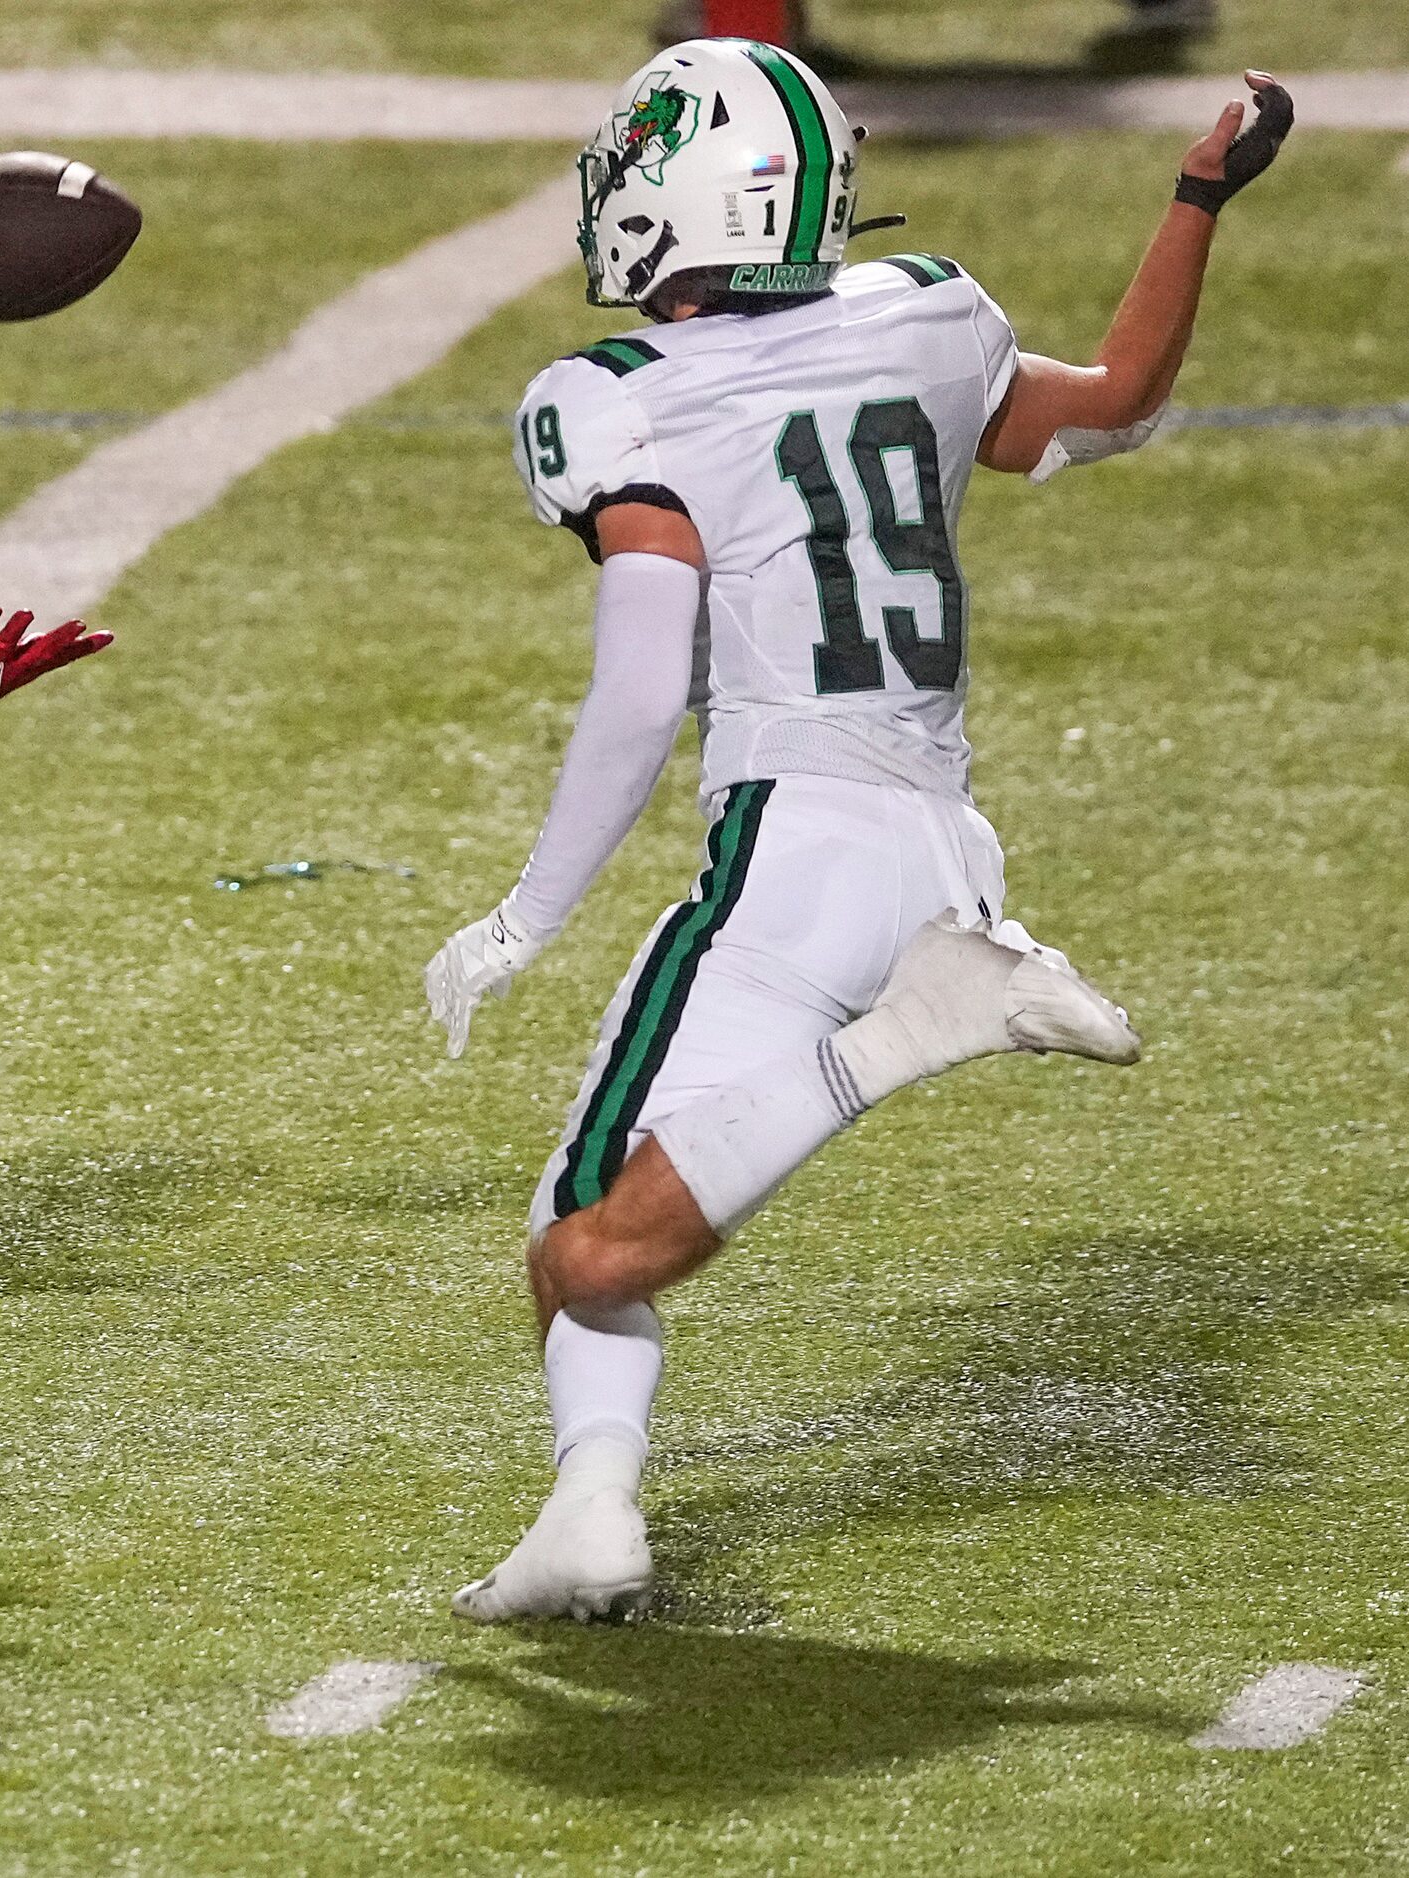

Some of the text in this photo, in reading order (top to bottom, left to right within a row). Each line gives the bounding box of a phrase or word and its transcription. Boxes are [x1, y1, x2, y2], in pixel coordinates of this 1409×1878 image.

[763, 199, 776, 236] 1
[830, 194, 848, 234] 9
[520, 404, 568, 486] 19
[773, 396, 963, 695] 19
